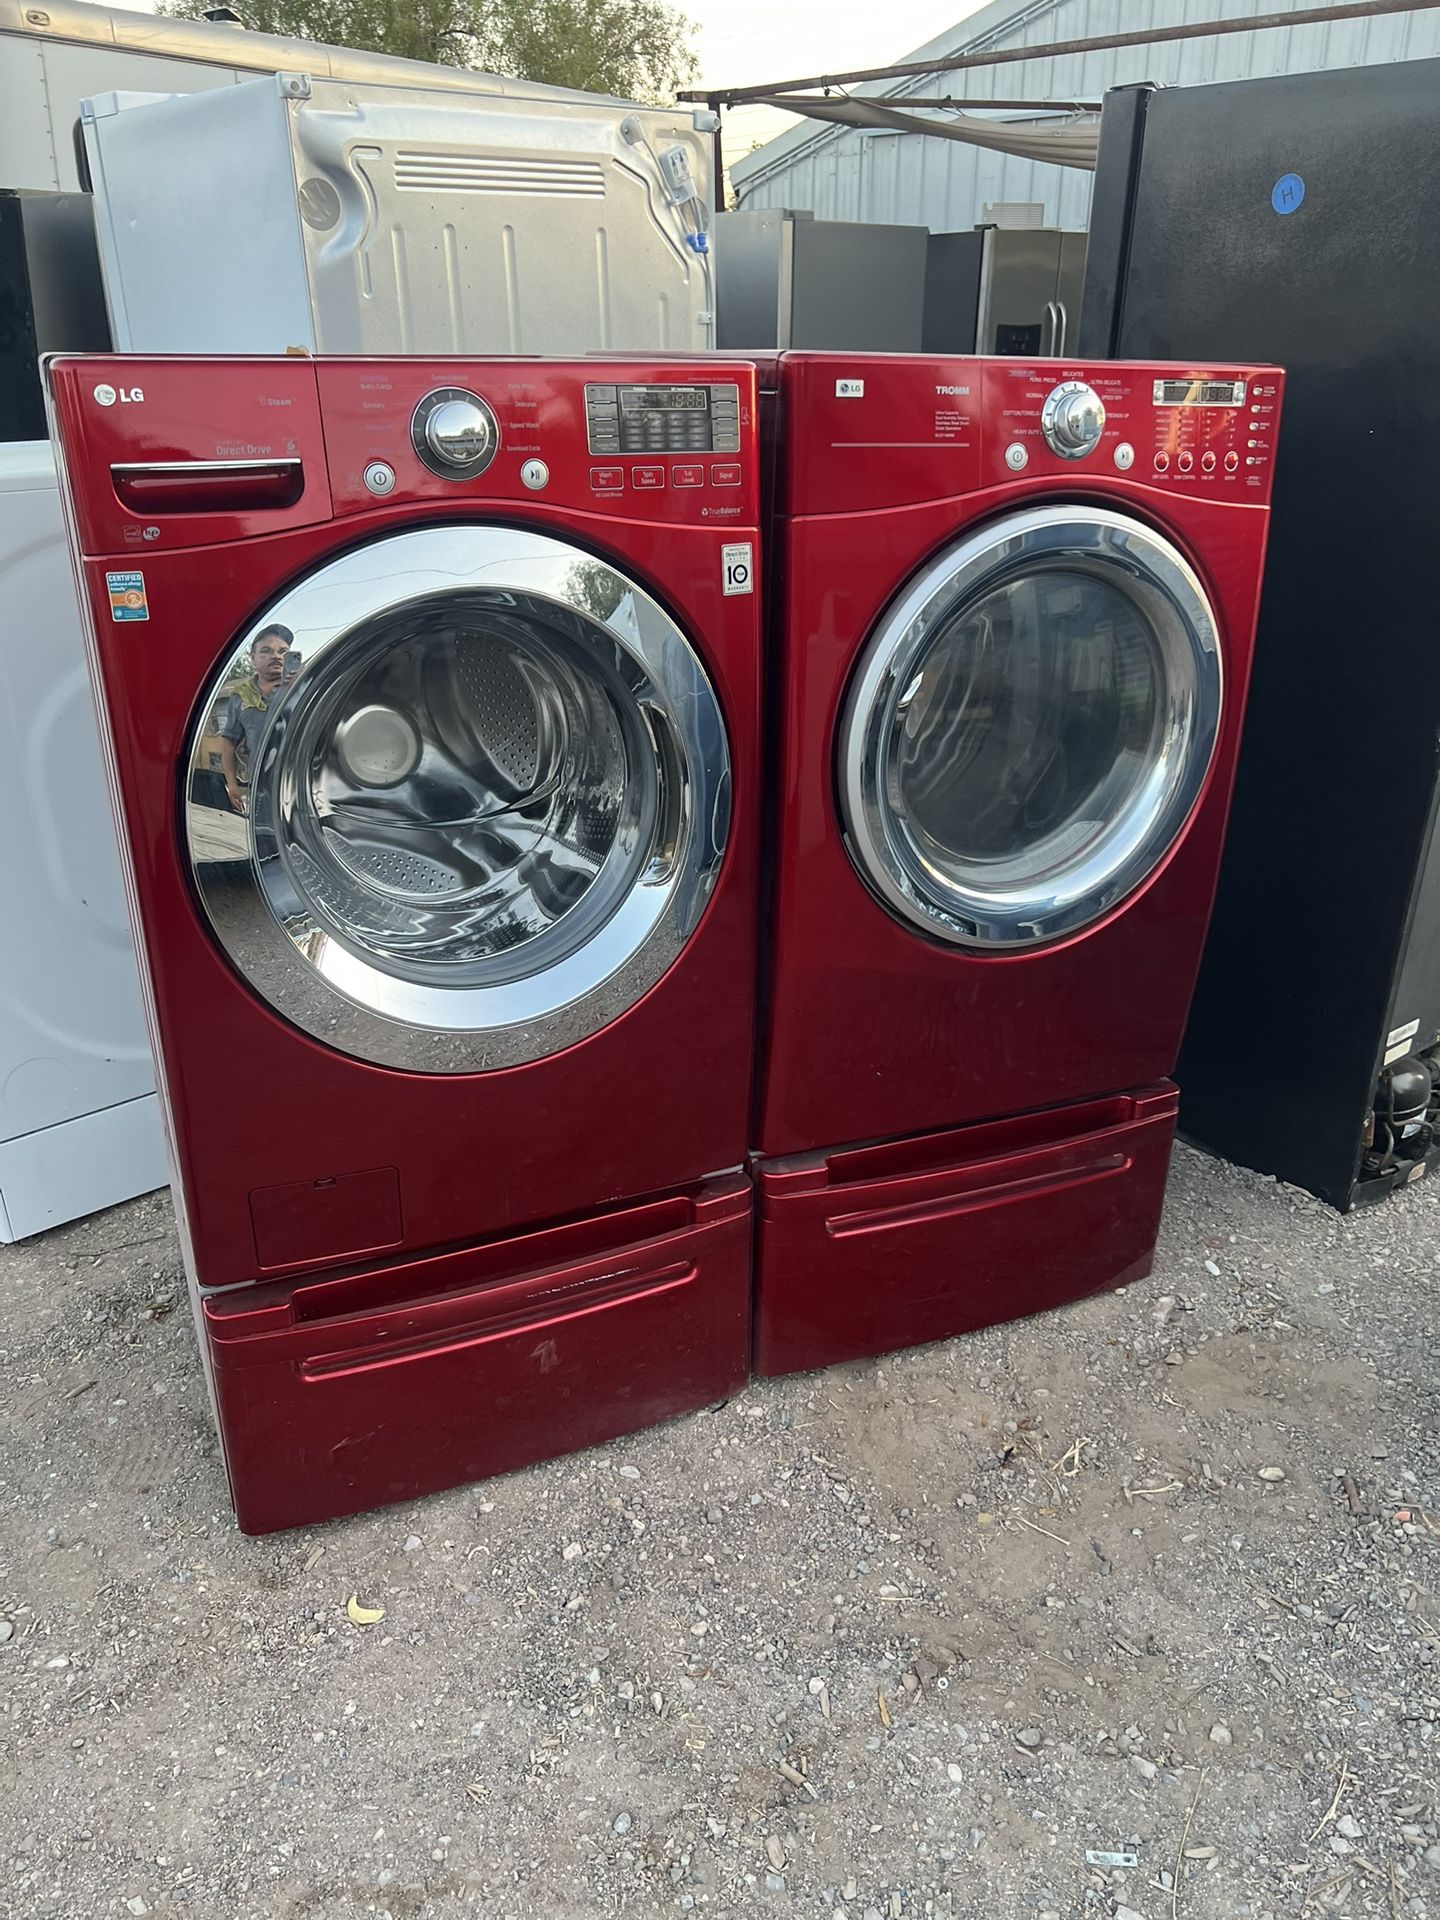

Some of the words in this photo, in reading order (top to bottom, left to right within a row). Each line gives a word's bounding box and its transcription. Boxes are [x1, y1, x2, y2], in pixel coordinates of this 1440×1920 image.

[1281, 185, 1294, 205] H
[850, 384, 861, 393] LG
[935, 385, 970, 395] TROMM
[119, 387, 145, 403] LG
[267, 397, 293, 406] Steam
[509, 421, 526, 430] Speed
[526, 421, 540, 429] Wash
[216, 445, 246, 456] Direct
[247, 444, 272, 455] Drive
[108, 573, 142, 582] CERTIFIED
[727, 564, 748, 585] 10
